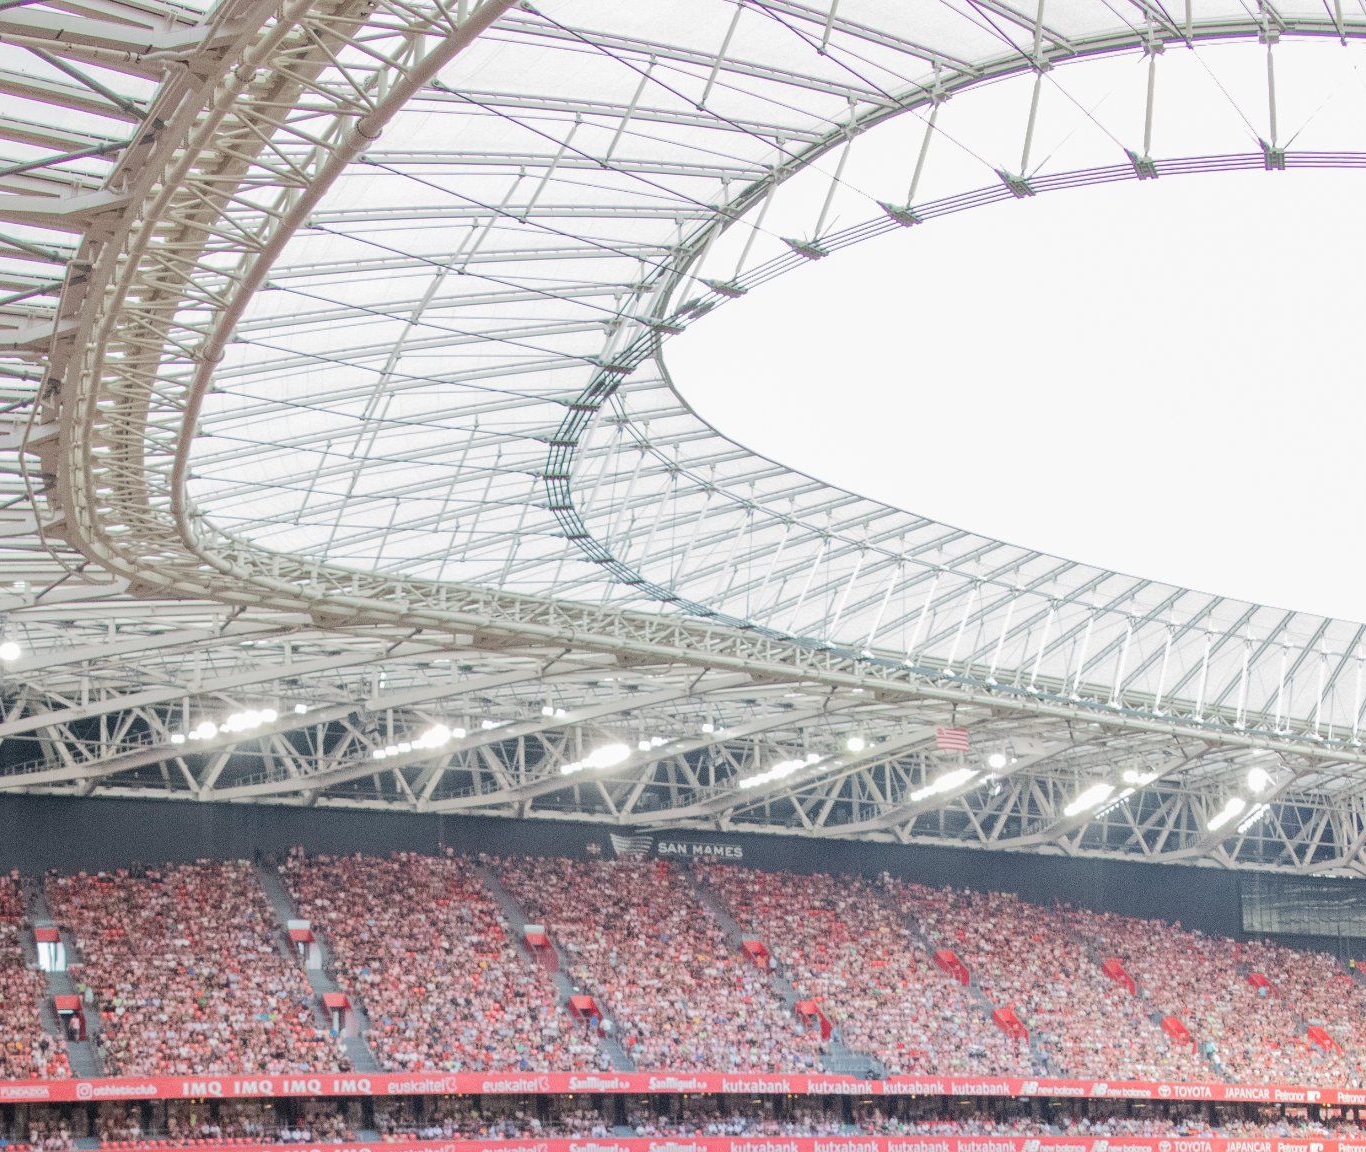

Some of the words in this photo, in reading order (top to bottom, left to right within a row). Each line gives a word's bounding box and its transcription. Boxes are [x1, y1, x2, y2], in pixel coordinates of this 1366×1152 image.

[658, 843, 687, 855] SAN
[692, 845, 743, 858] MAMES
[182, 1081, 222, 1098] IMQ
[234, 1080, 272, 1096] IMQ
[283, 1079, 321, 1095] IMQ
[334, 1078, 371, 1094] IMQ
[388, 1077, 445, 1092] euskaltel
[482, 1077, 538, 1092] euskaltel
[722, 1079, 790, 1094] kutxabank
[808, 1081, 872, 1095] kutxabank
[883, 1082, 944, 1095] kutxabank
[951, 1083, 1010, 1096] kutxabank
[1174, 1087, 1211, 1098] TOYOTA
[1224, 1088, 1269, 1100] JAPANCAR
[1174, 1141, 1211, 1152] TOYOTA
[1226, 1141, 1271, 1152] JAPANCAR
